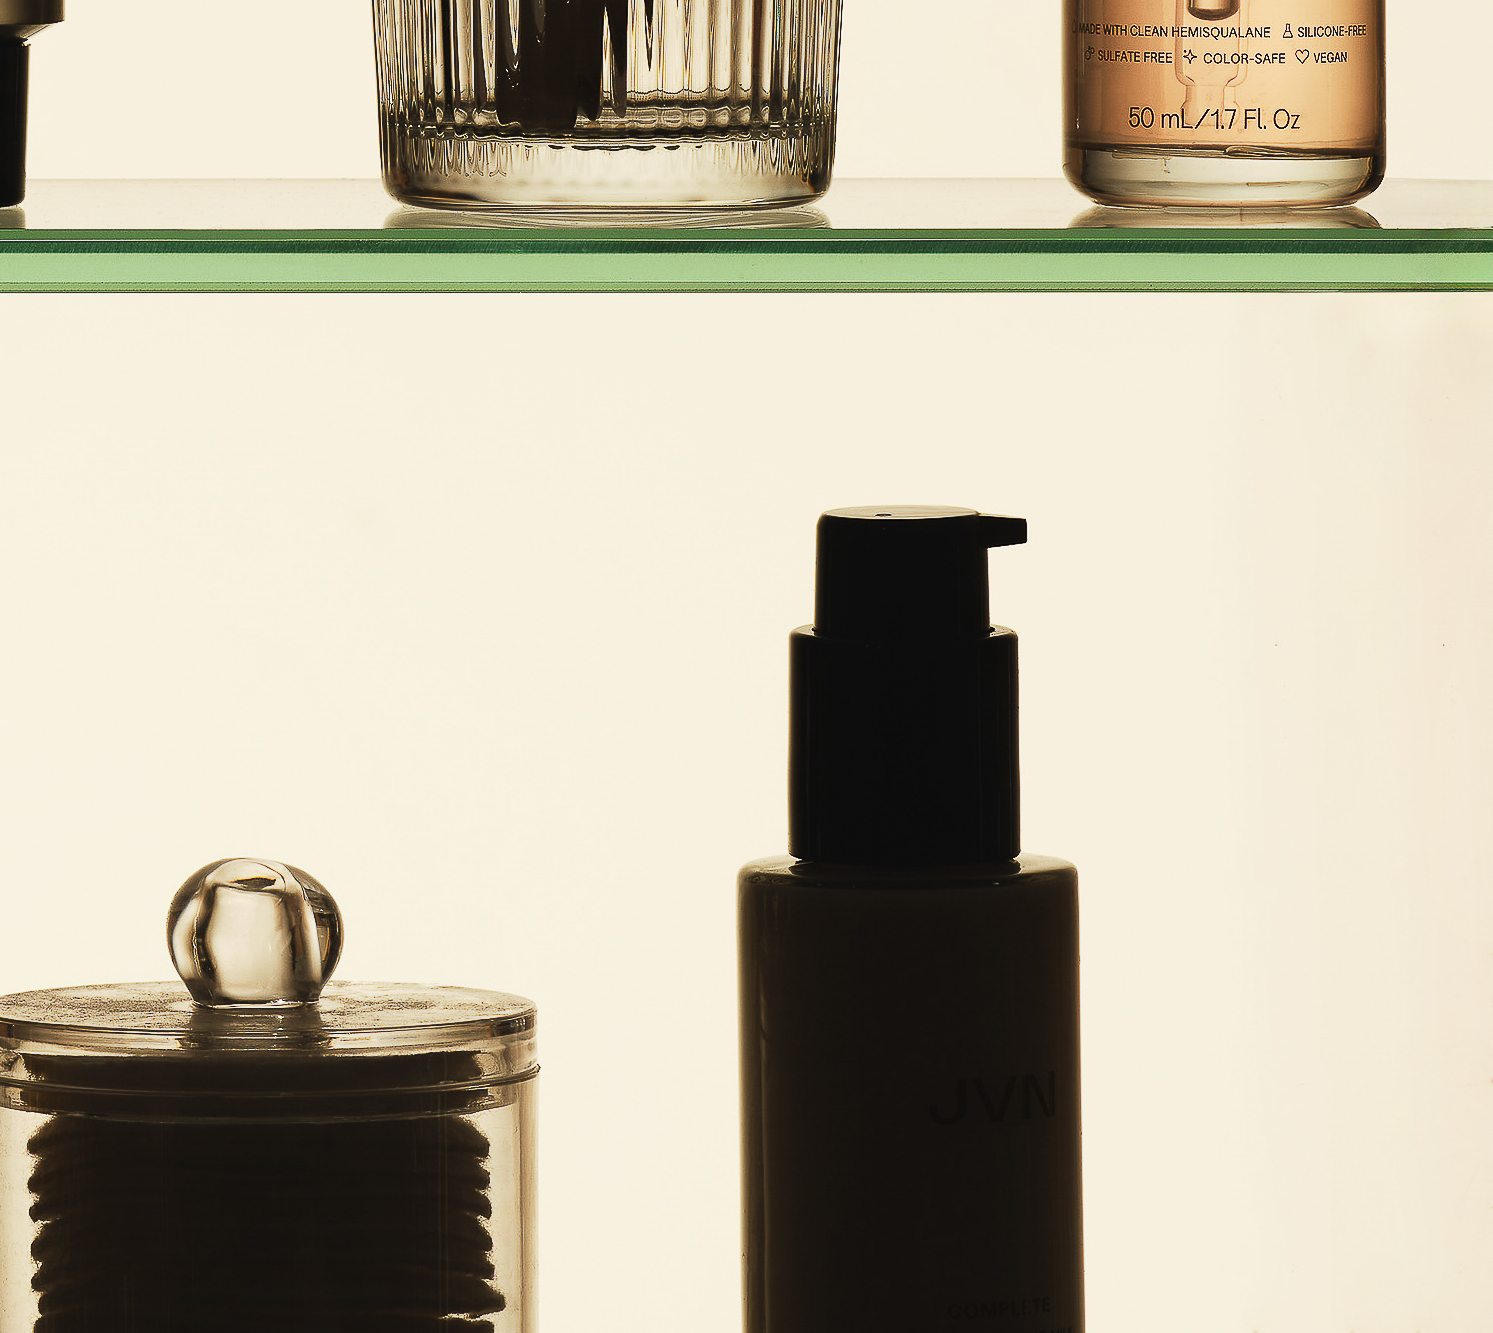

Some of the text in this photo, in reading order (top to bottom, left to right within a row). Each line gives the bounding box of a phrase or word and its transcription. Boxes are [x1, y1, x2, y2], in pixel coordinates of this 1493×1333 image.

[1079, 23, 1367, 40] MADE WITH CLEAN HEMISQUALANE SILICONE-FREE
[1097, 49, 1348, 64] SULFATE FREE COLOR-SAFE VEGAN
[1128, 106, 1154, 128] 50
[1244, 107, 1267, 130] Fl.
[1273, 108, 1301, 130] Oz
[929, 1070, 1055, 1125] JVN
[947, 1296, 1051, 1321] COMPLETE
